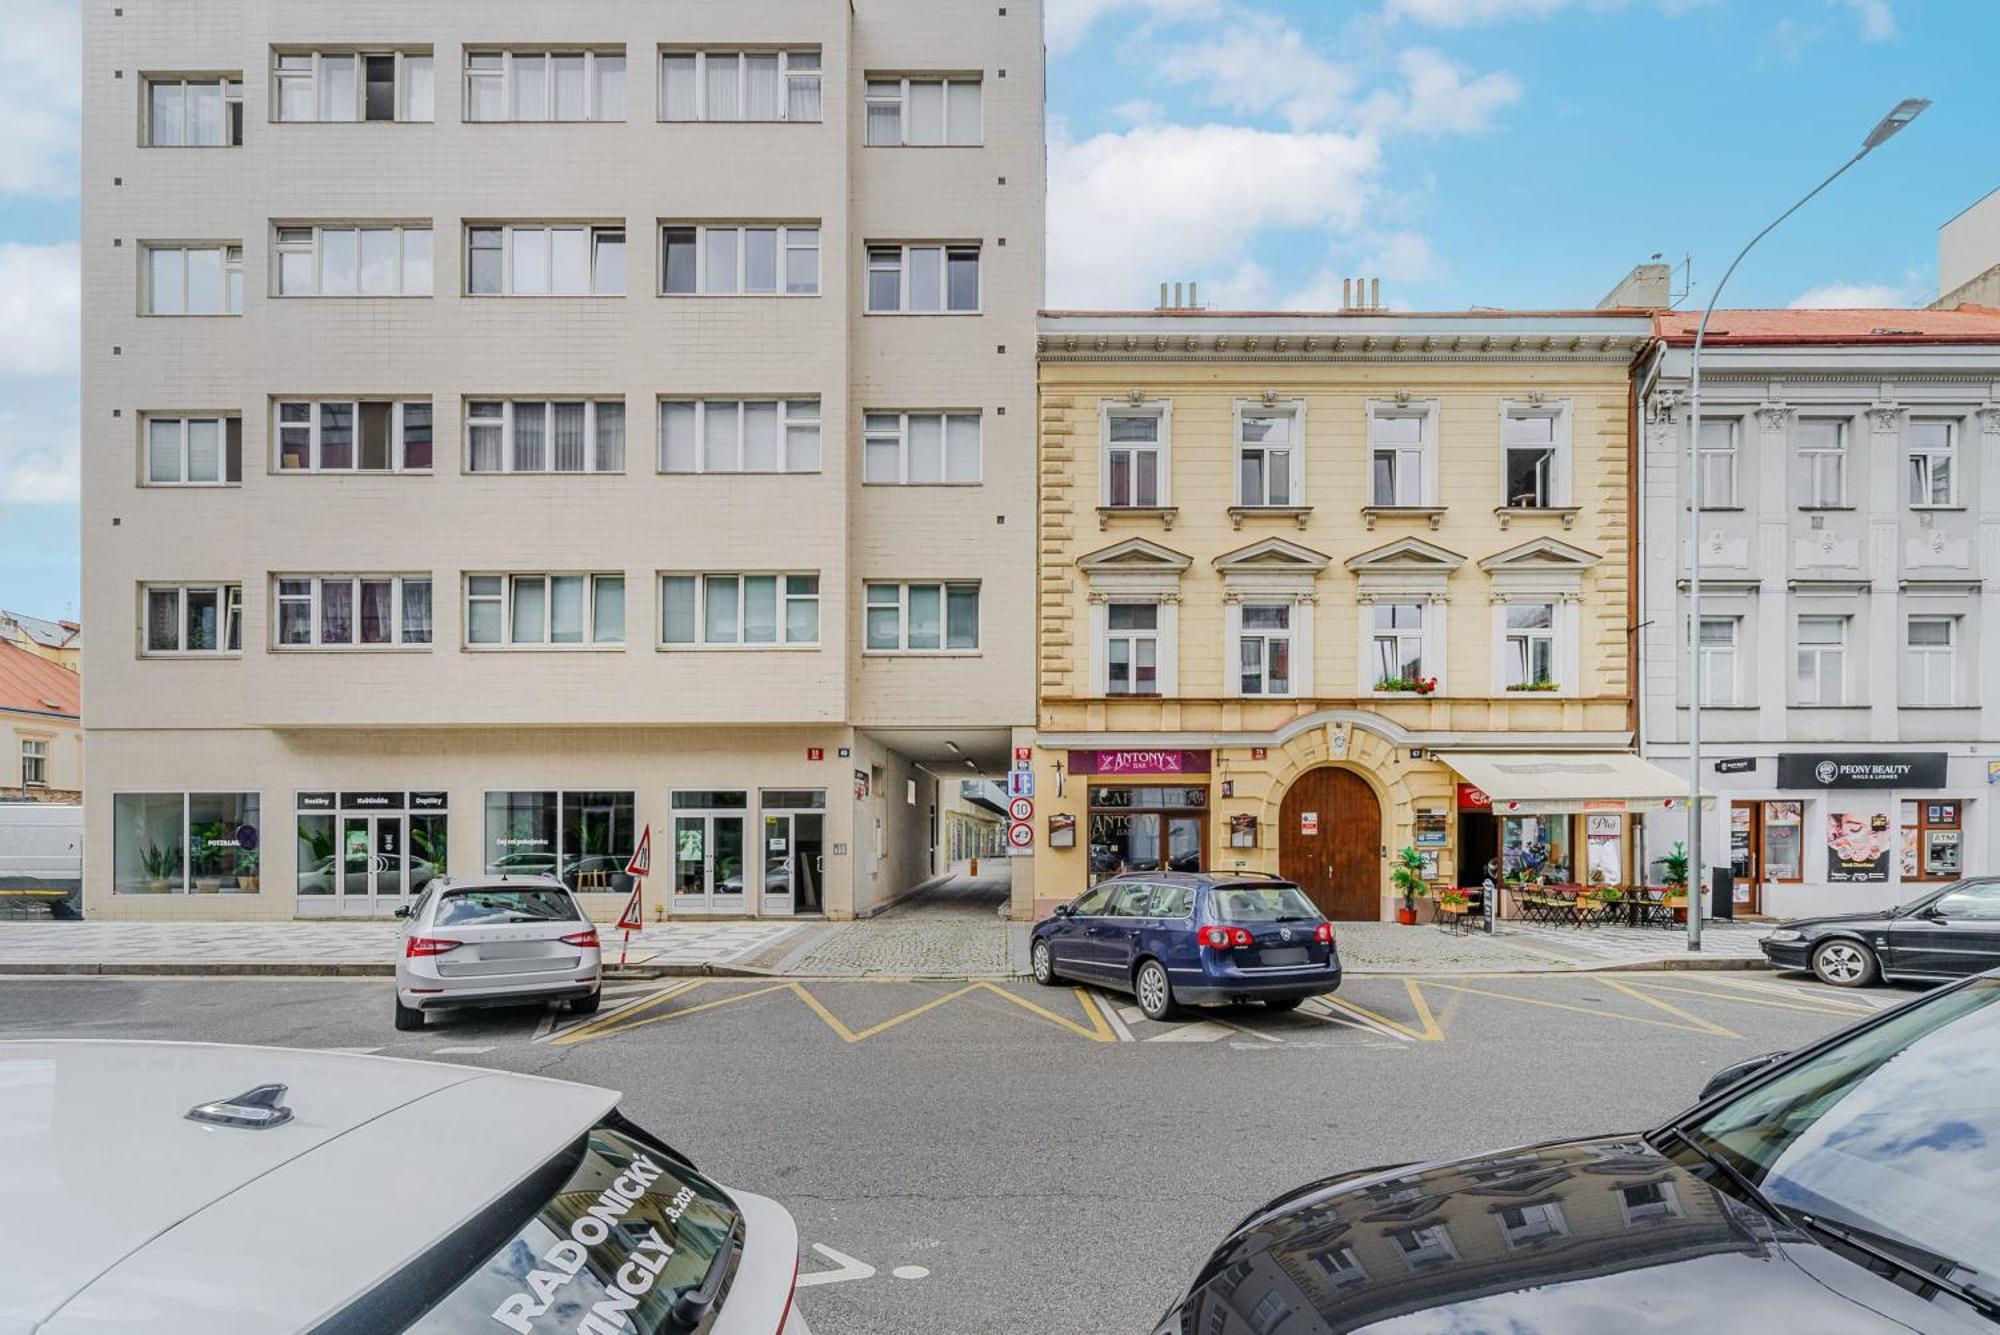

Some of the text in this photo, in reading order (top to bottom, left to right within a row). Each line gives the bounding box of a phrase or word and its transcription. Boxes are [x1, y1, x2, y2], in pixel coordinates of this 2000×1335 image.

[1113, 752, 1165, 771] ANTONY
[1840, 764, 1912, 774] PEONY BEAUTY
[1015, 803, 1028, 815] 10
[1934, 833, 1955, 841] ATM
[491, 1152, 663, 1335] RADONICKÝ
